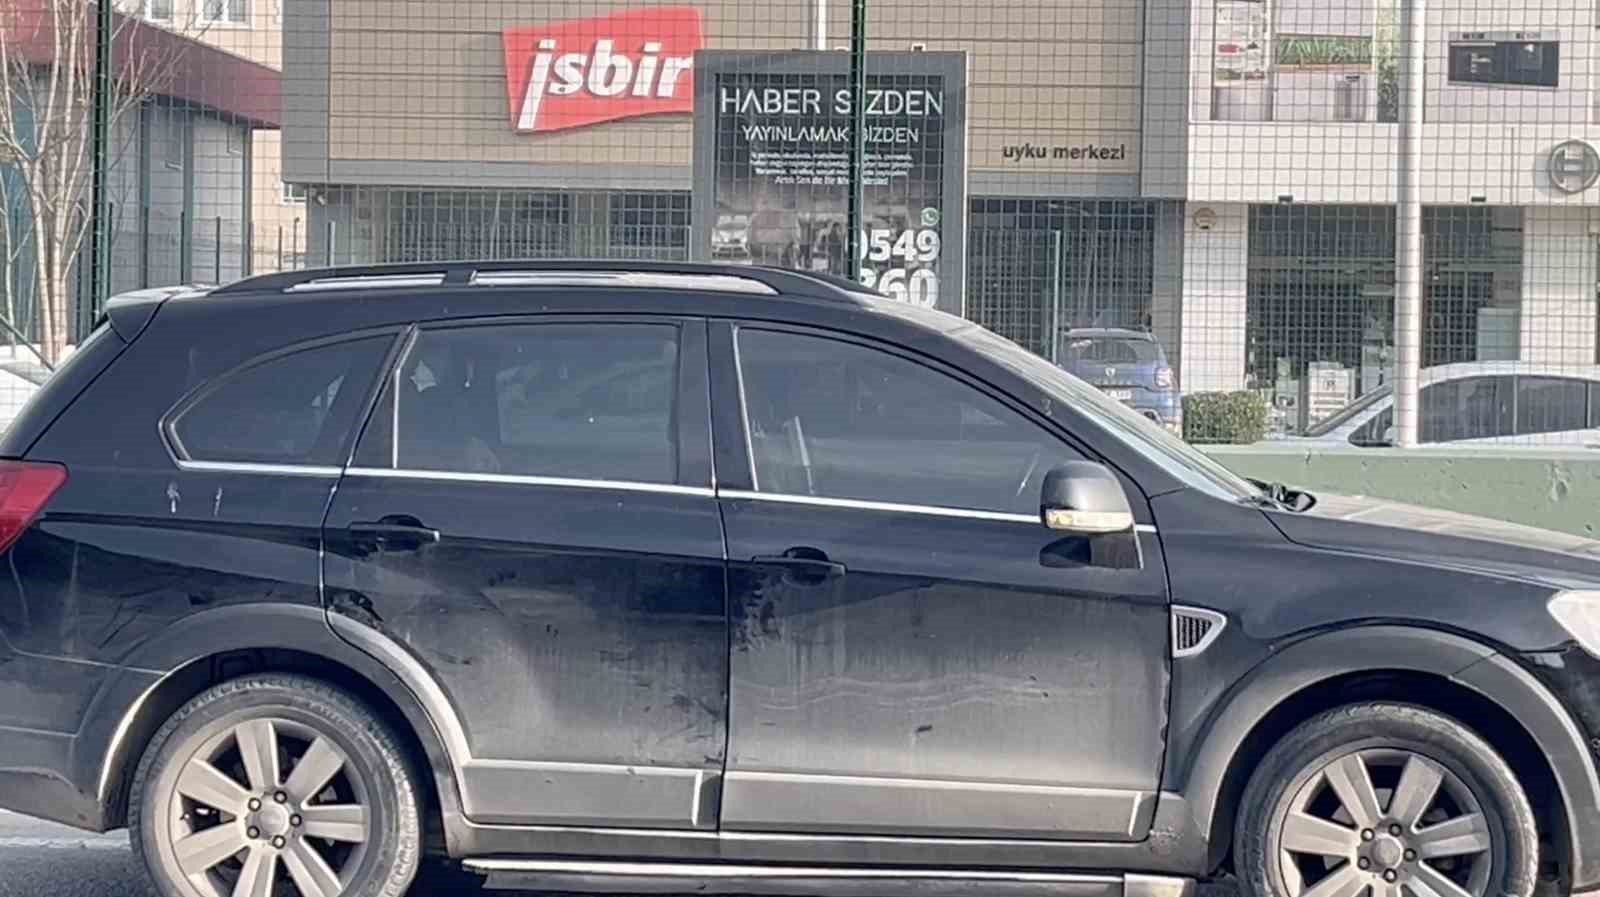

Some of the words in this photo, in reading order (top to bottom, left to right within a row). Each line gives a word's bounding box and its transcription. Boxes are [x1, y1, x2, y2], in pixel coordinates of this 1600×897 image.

[720, 88, 821, 114] HABER
[834, 89, 943, 116] SZDEN
[742, 125, 849, 142] YAYINLAMAK
[1003, 142, 1047, 162] uyku
